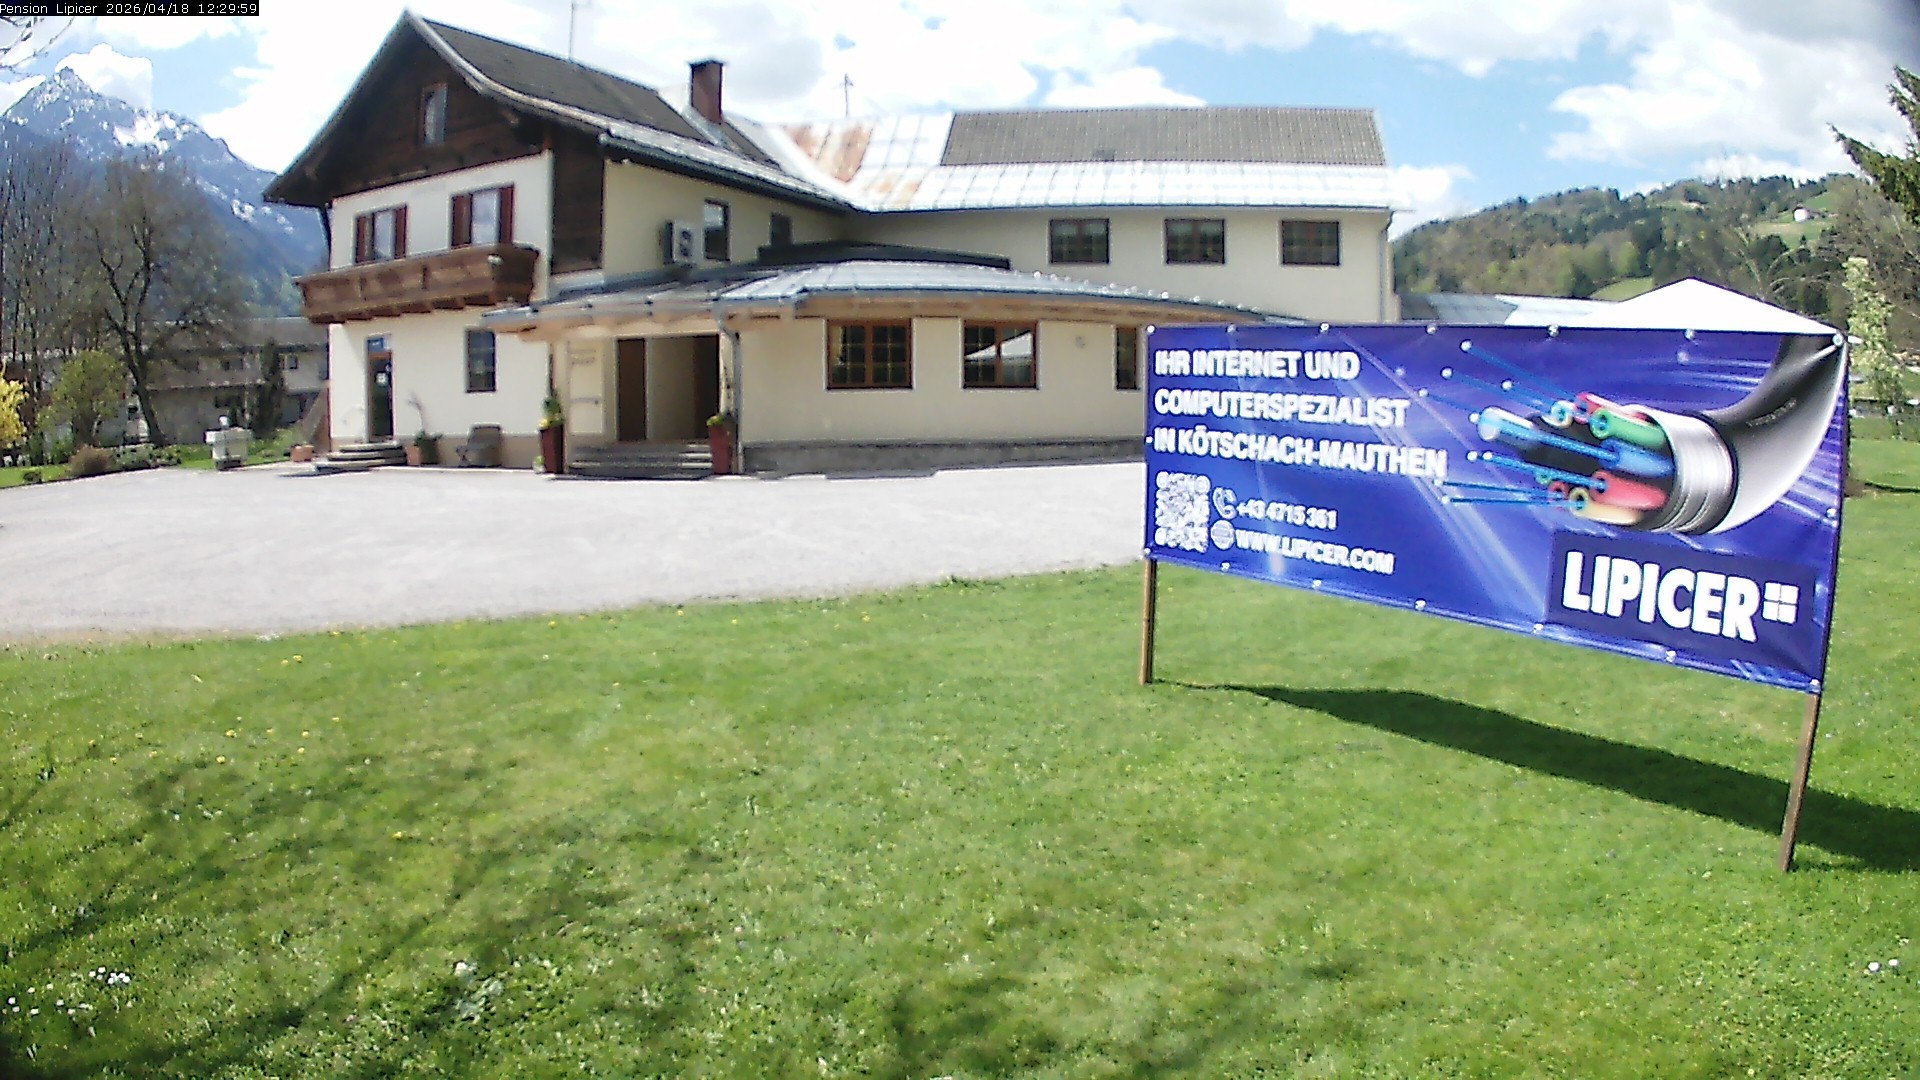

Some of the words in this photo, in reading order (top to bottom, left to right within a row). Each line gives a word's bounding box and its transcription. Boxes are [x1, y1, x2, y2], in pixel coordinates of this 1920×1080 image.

[1155, 350, 1190, 376] IHR
[1192, 350, 1302, 379] INTERNET
[1304, 351, 1361, 380] UND
[1154, 388, 1411, 428] COMPUTERSPEZIALIST
[1154, 426, 1176, 453] IN
[1178, 424, 1448, 477] KÖTSCHACH-MAUTHEN
[1237, 499, 1265, 519] +43
[1265, 501, 1306, 524] 4715
[1235, 528, 1395, 575] WWW.LIPICER.COM
[1562, 551, 1761, 643] LIPICER
